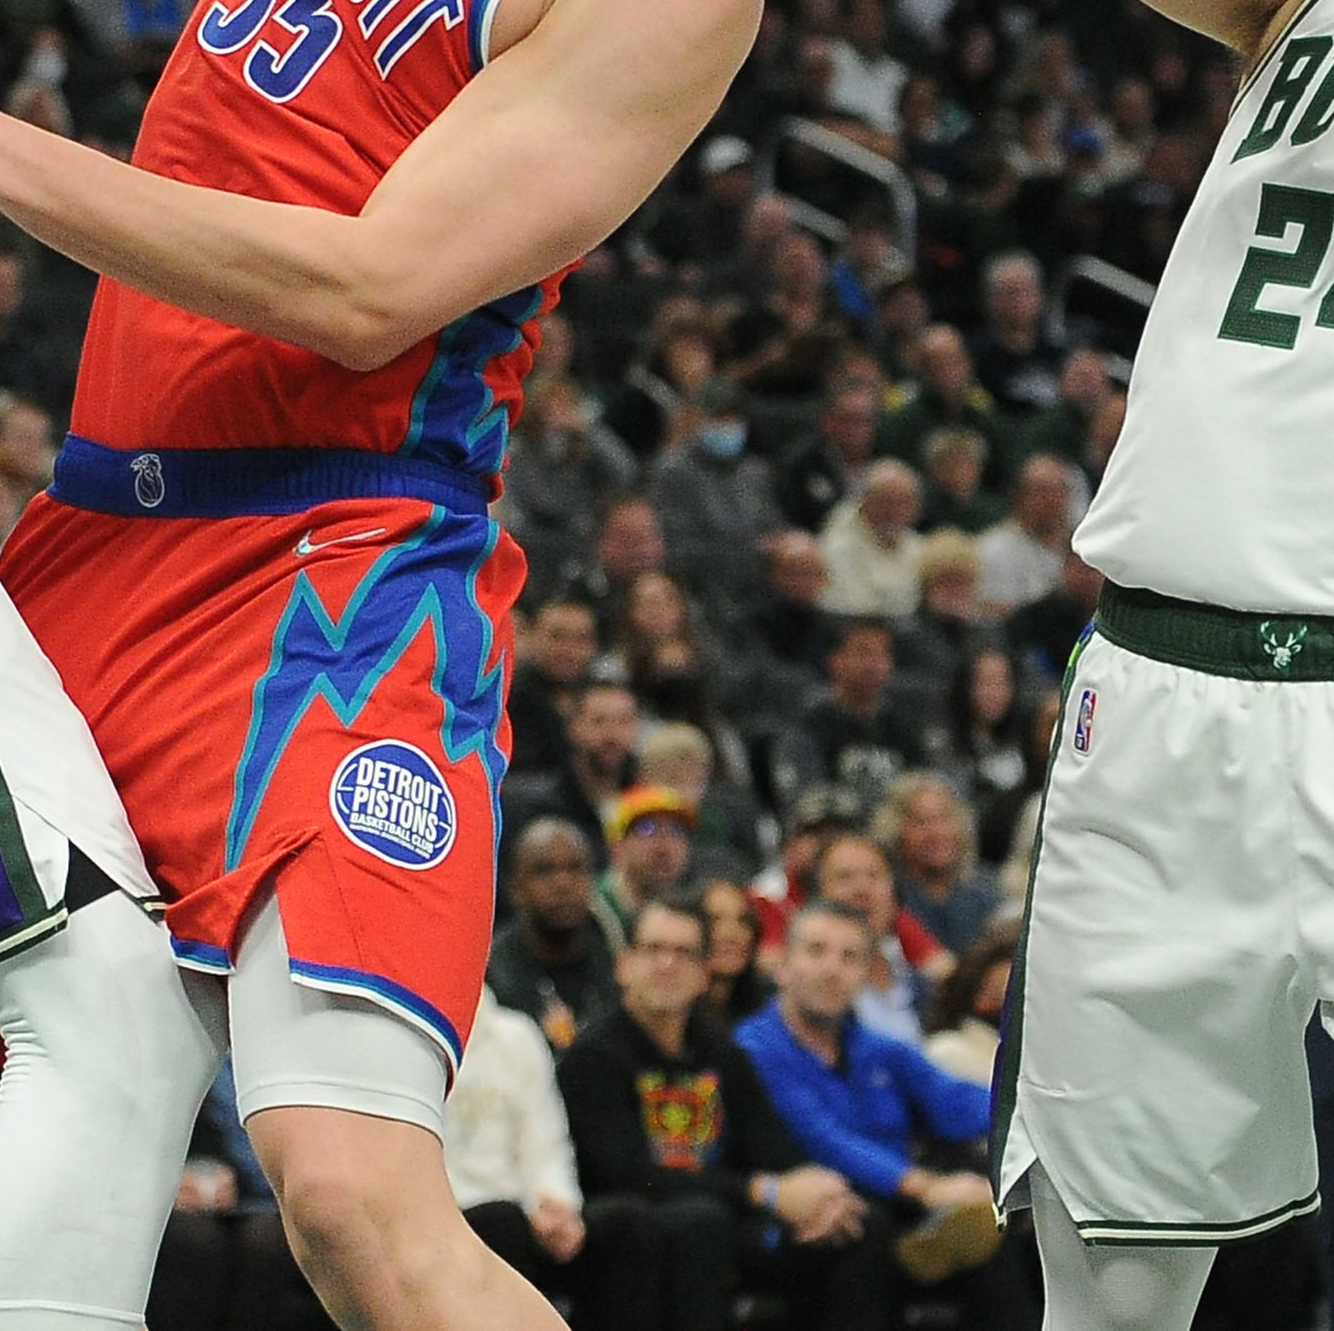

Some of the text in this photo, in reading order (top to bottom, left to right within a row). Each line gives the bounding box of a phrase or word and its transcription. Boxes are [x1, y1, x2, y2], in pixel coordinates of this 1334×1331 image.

[356, 756, 442, 813] DETROIT
[349, 812, 411, 842] BASKETBALL
[411, 833, 435, 854] CLUB
[351, 785, 440, 842] PISTONS
